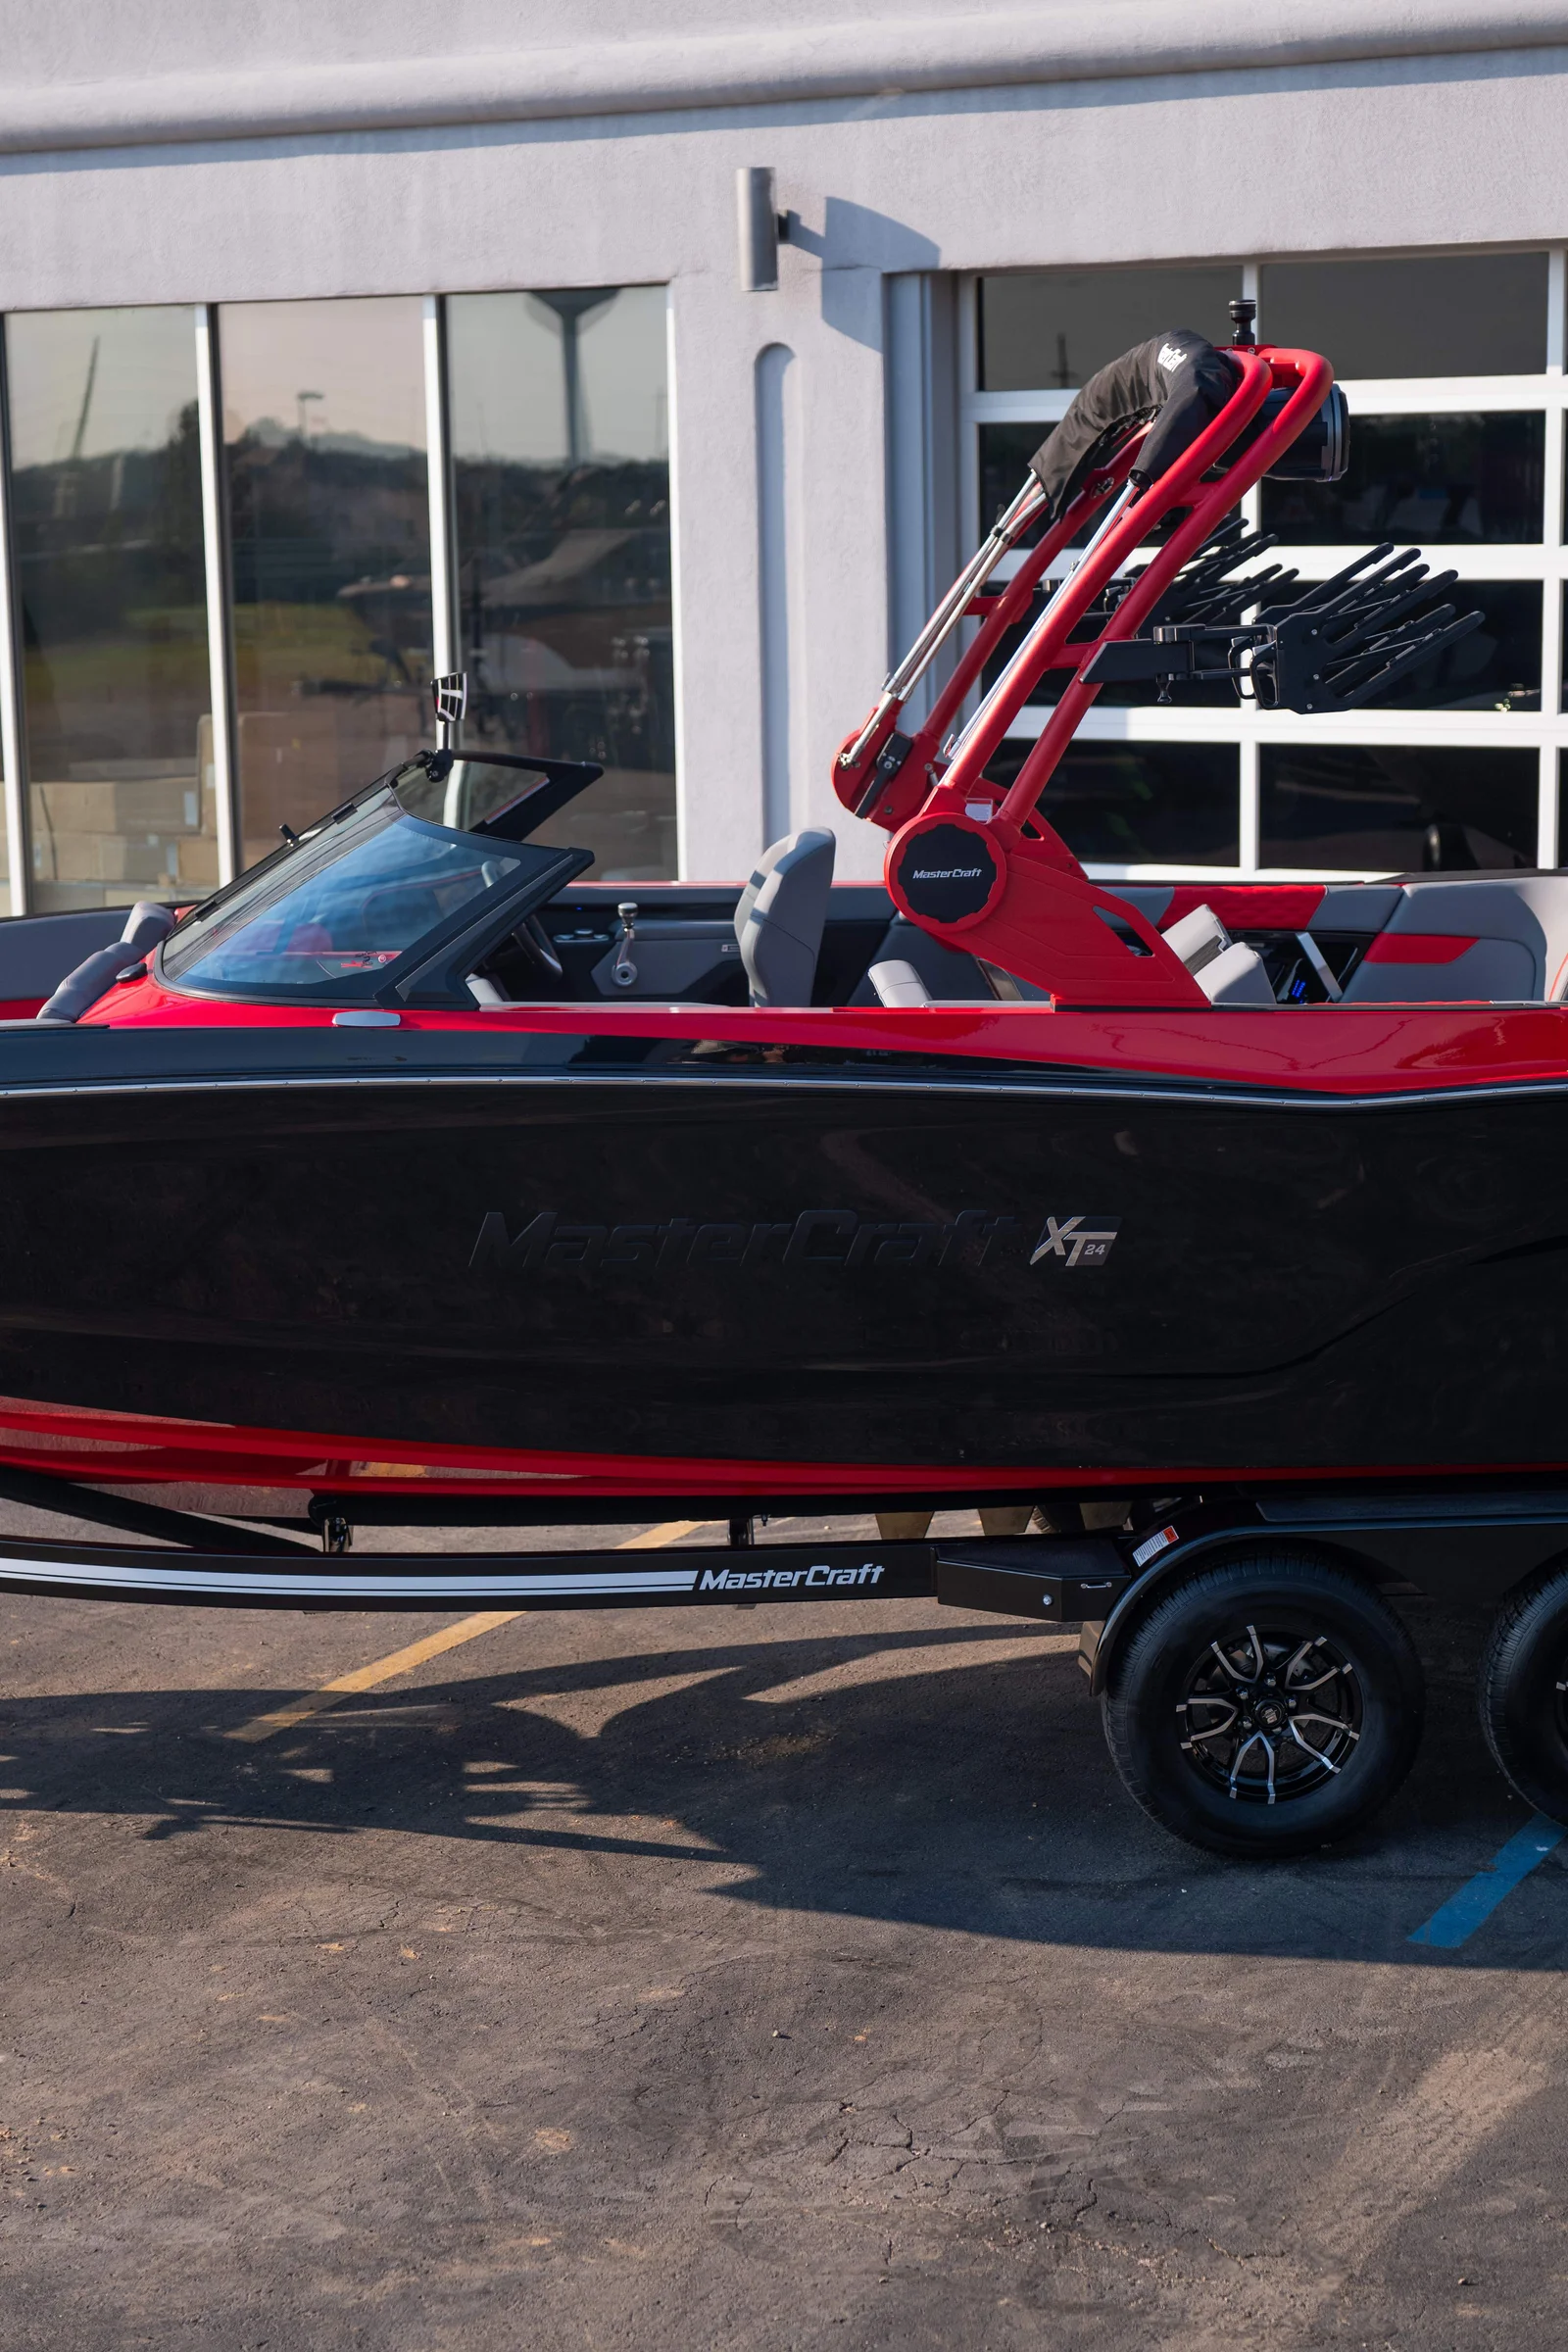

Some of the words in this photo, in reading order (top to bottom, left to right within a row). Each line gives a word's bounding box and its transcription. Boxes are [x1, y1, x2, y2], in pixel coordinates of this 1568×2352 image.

[912, 868, 982, 879] MasterCraft
[467, 1209, 1023, 1267] MasterCraft
[1029, 1215, 1117, 1266] XT
[1084, 1244, 1105, 1255] 24
[699, 1563, 885, 1591] MasterCraft
